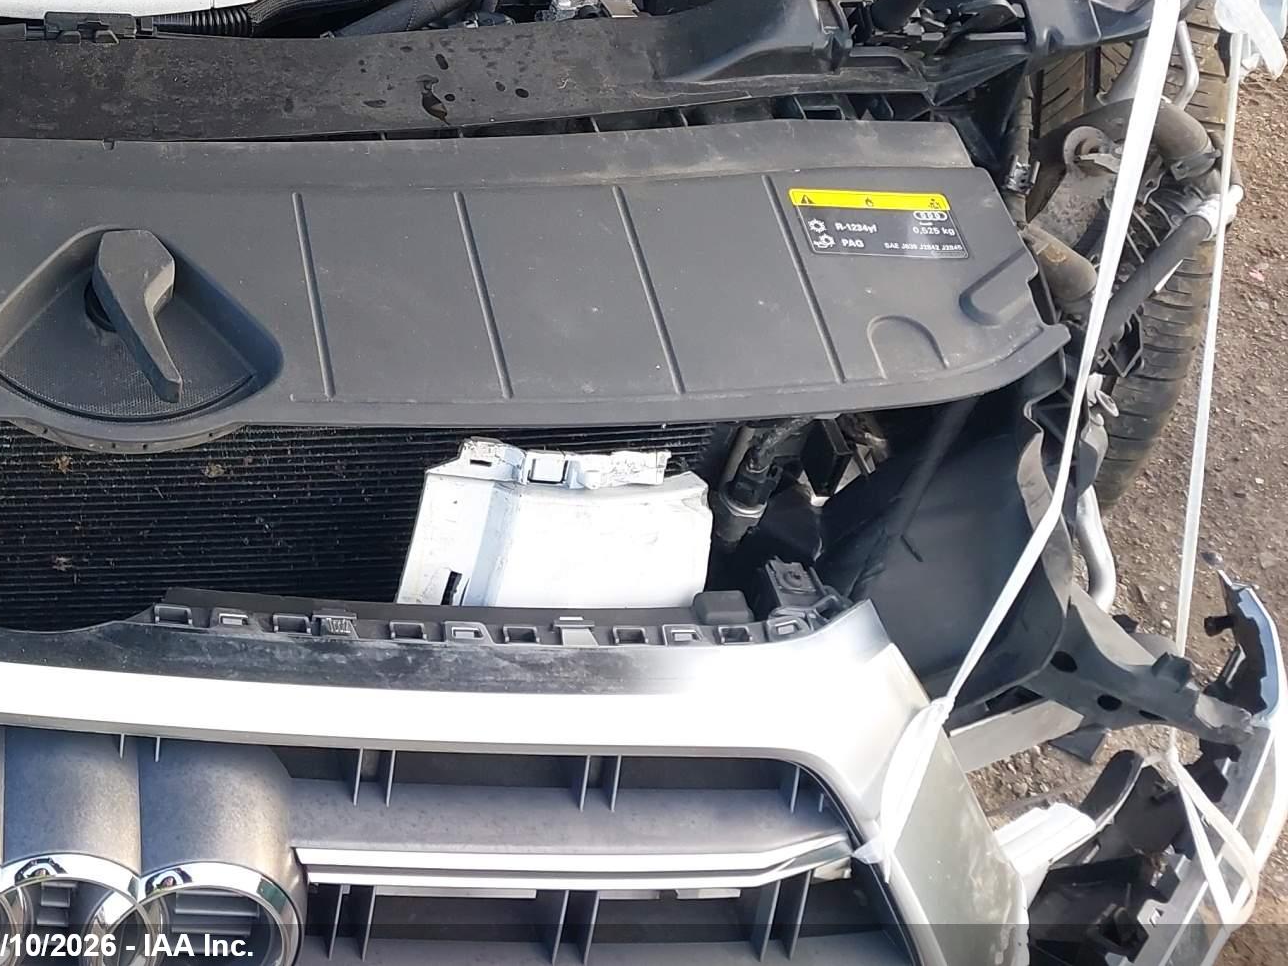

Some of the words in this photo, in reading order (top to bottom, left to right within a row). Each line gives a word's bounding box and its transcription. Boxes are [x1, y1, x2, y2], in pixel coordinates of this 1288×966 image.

[912, 226, 940, 235] 0,525
[942, 227, 956, 237] kg
[841, 238, 865, 248] PAG
